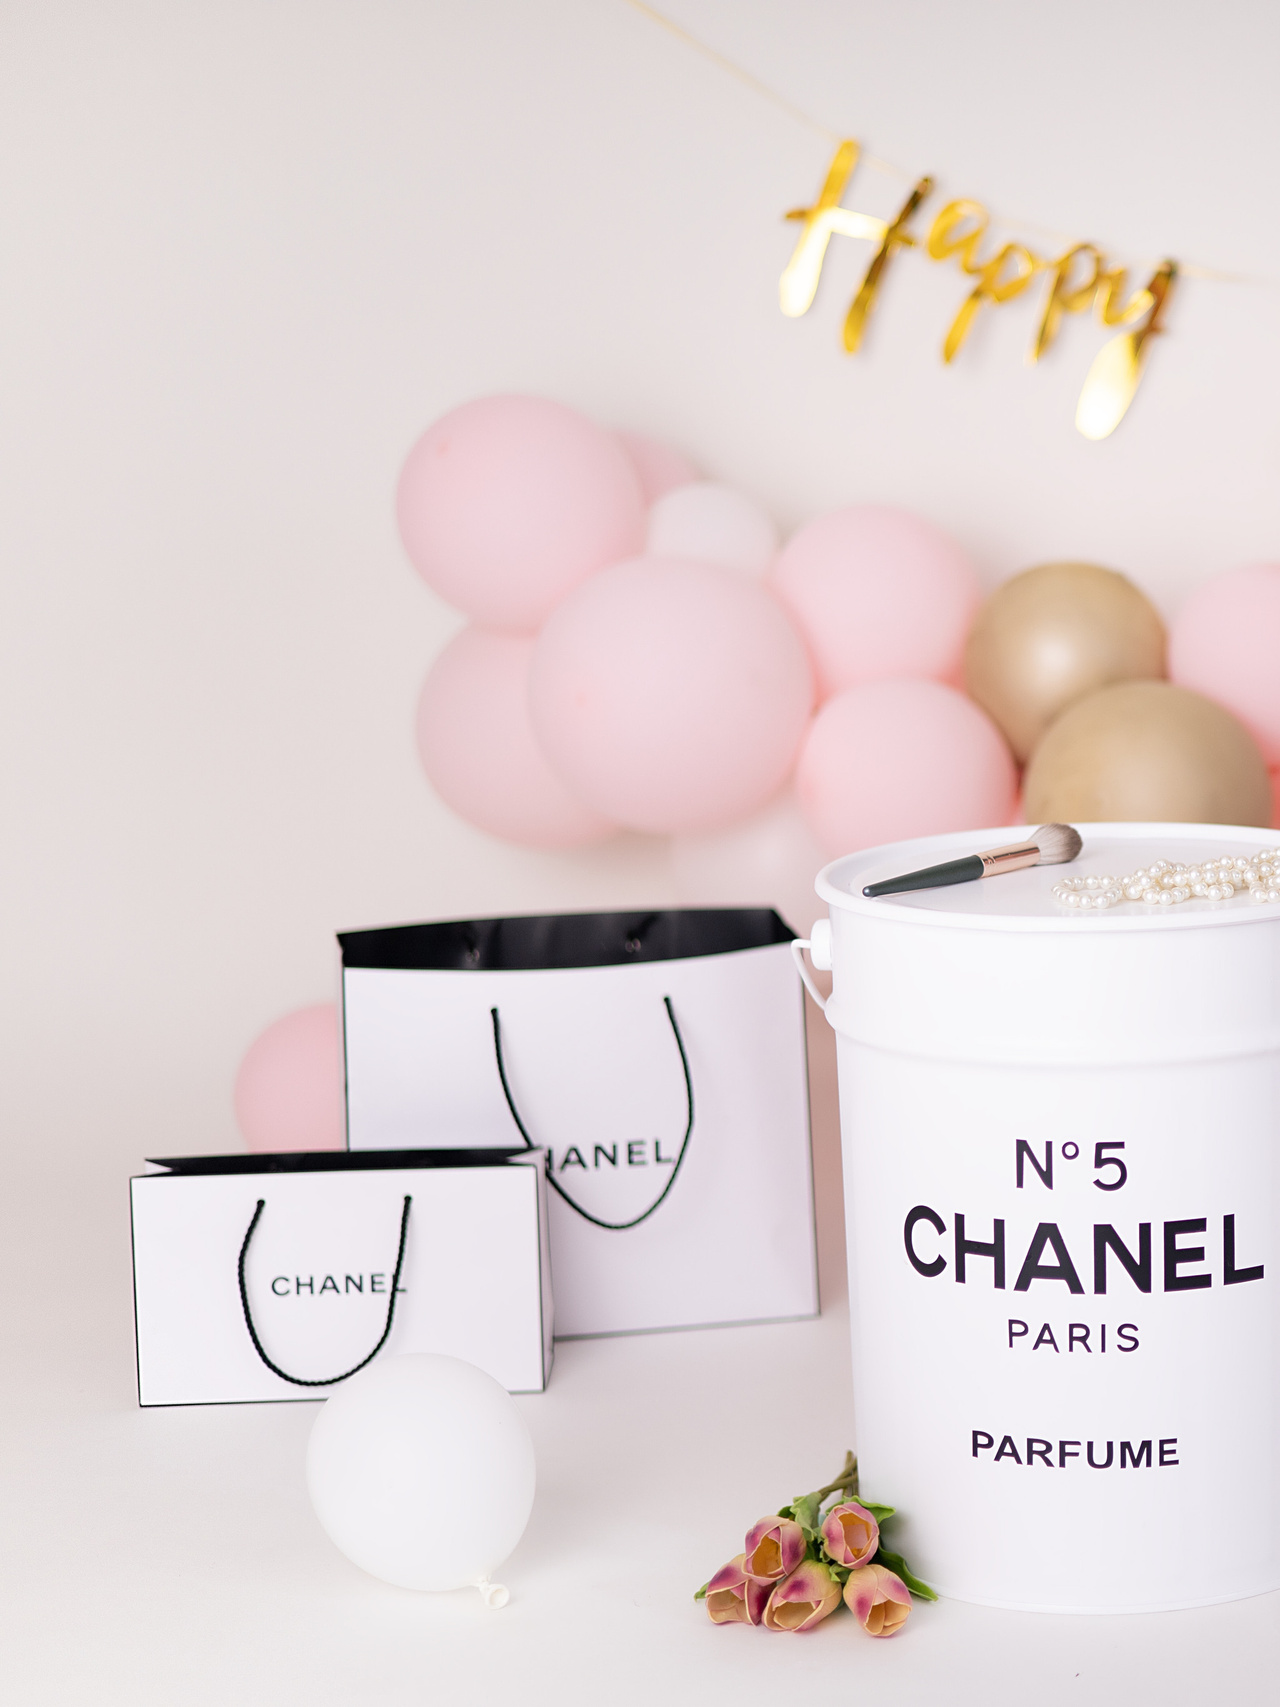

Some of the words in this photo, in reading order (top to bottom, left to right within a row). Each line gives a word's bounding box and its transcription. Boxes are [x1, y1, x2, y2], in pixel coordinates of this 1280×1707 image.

[780, 139, 1178, 440] Happy
[903, 1204, 1265, 1295] CHANEL
[1008, 1318, 1140, 1354] PARIS
[971, 1429, 1180, 1469] PARFUME
